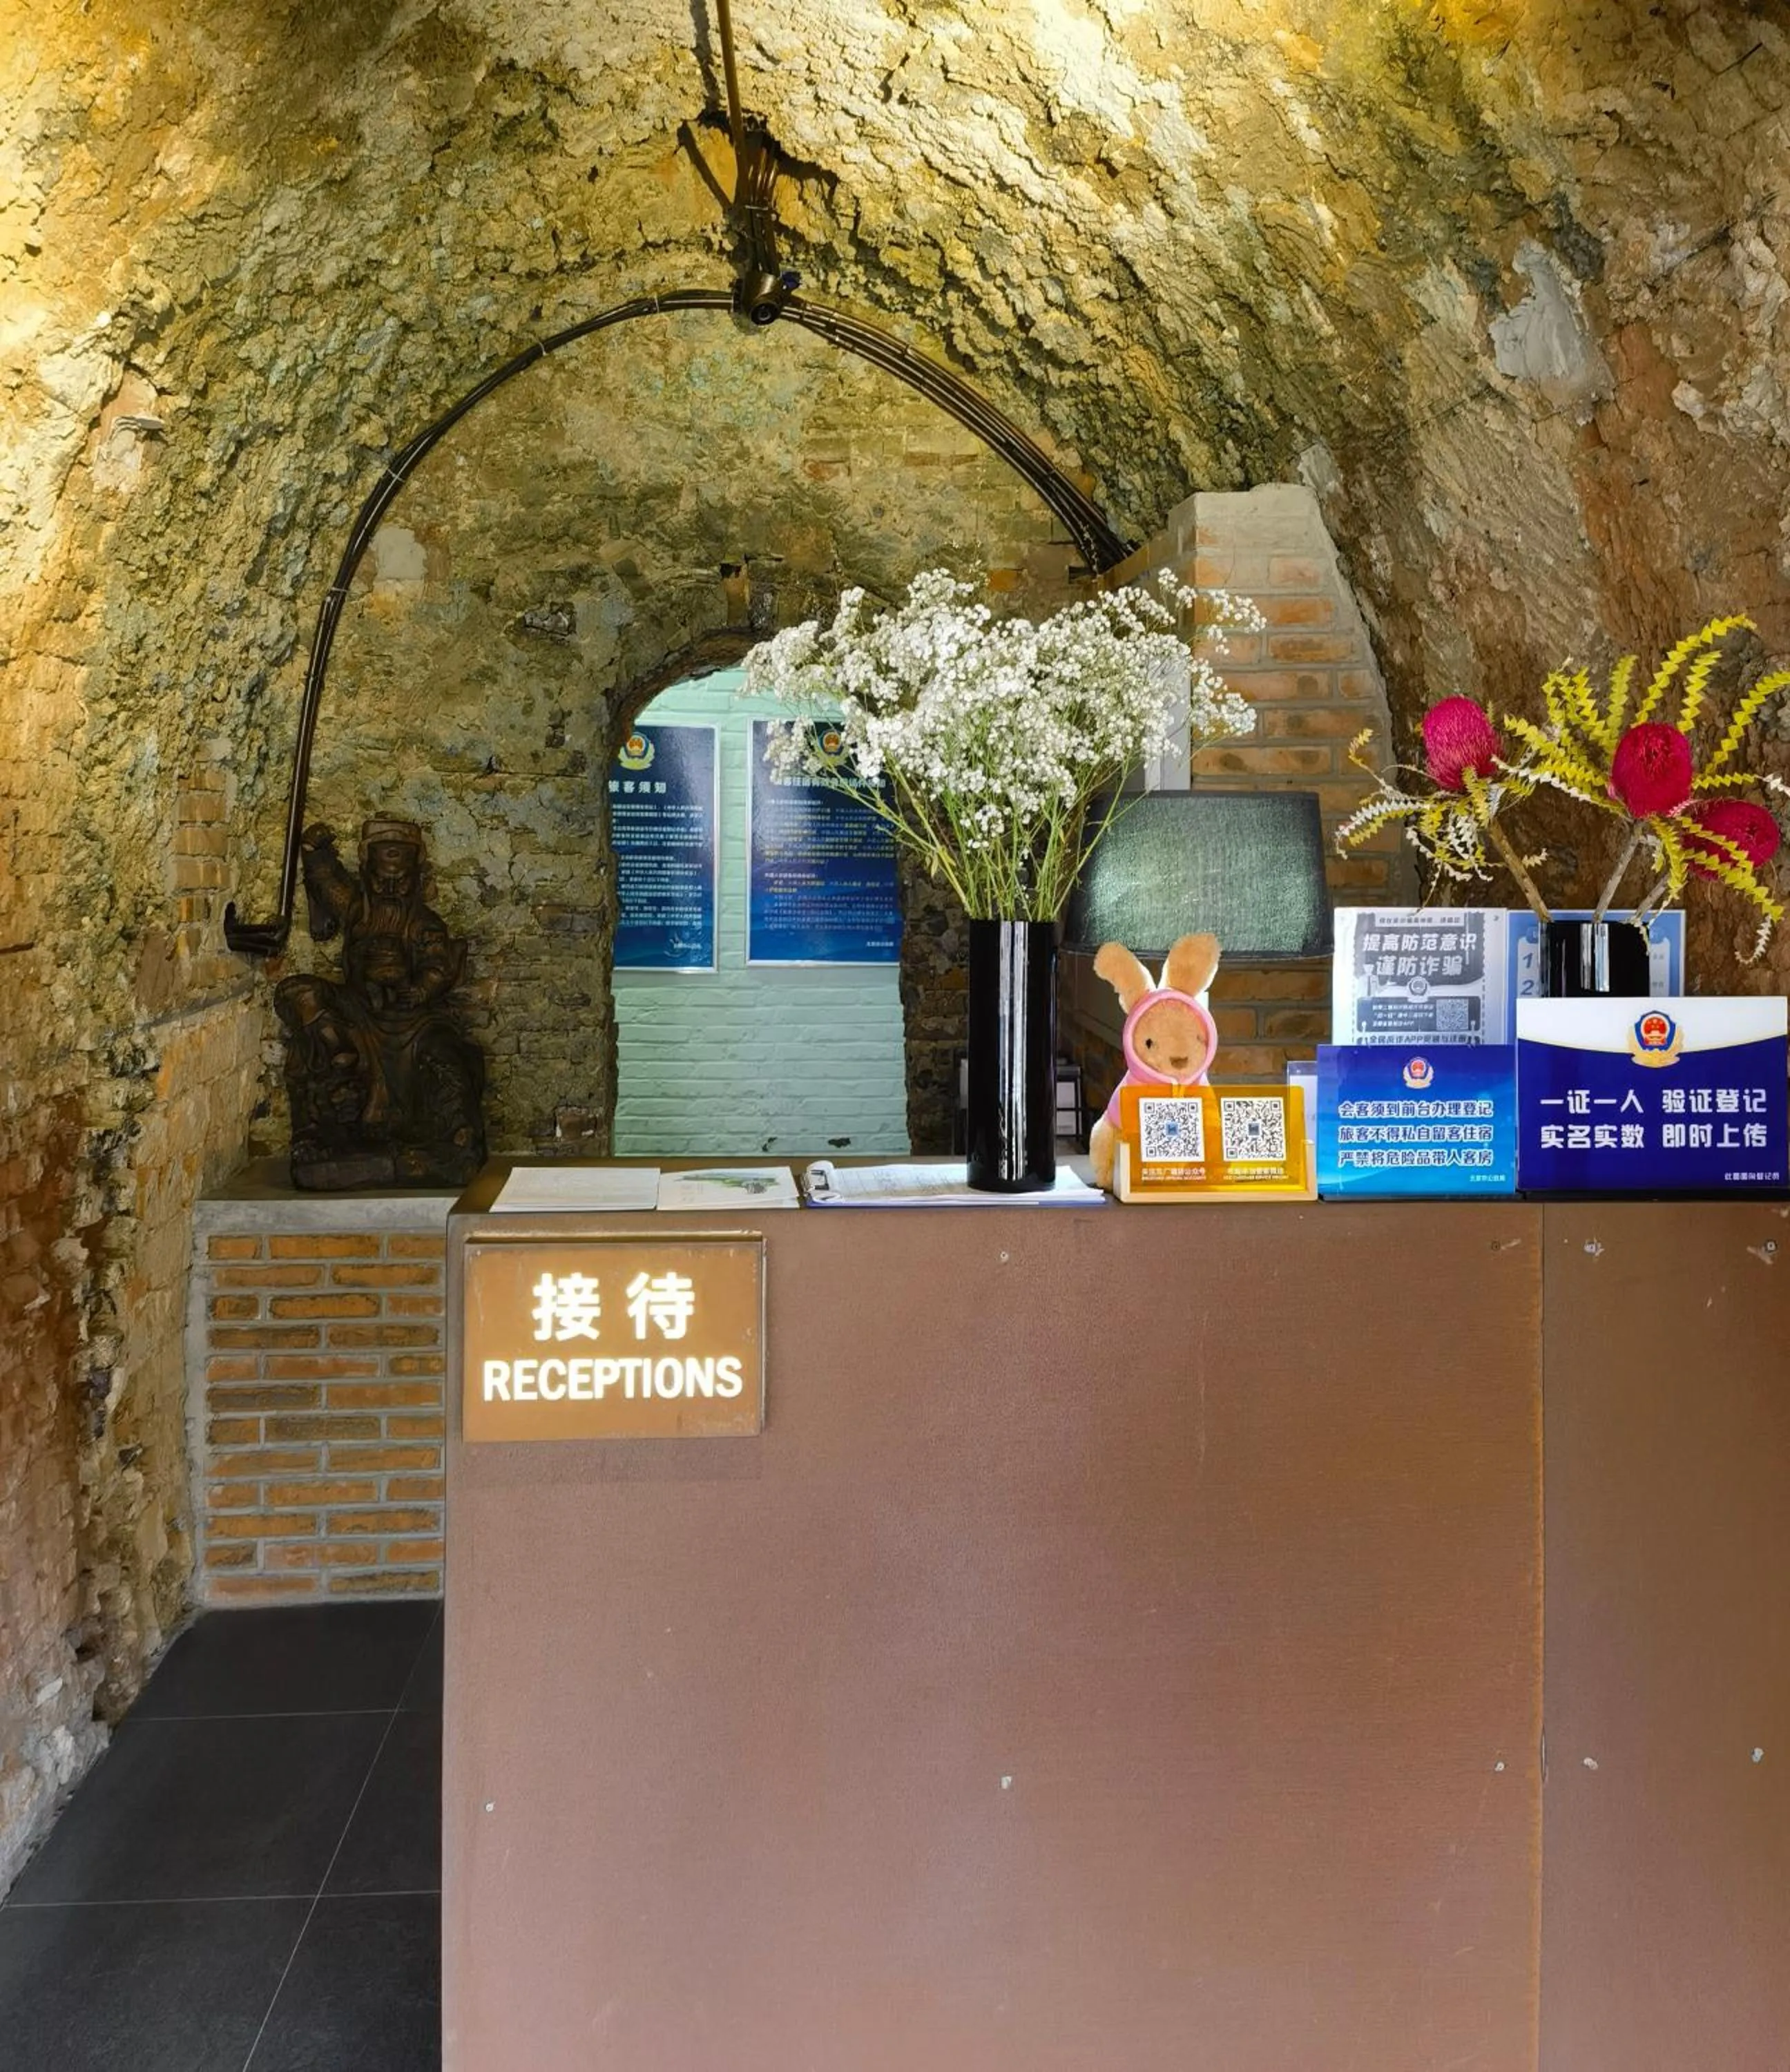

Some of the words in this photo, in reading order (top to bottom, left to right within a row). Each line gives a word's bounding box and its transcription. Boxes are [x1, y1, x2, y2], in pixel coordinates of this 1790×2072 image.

[1362, 932, 1478, 952] 提高防范意识
[1376, 955, 1463, 975] 谨防诈骗
[1338, 1100, 1494, 1118] 会客须到前台办理登记
[1540, 1088, 1644, 1114] 一证一人
[1662, 1088, 1767, 1114] 验证登记
[1338, 1124, 1494, 1143] 旅客不得私自留客住宿
[1540, 1124, 1645, 1149] 实名实数
[1662, 1123, 1767, 1149] 即时上传
[531, 1272, 696, 1342] 接待
[483, 1356, 742, 1403] RECEPTIONS
